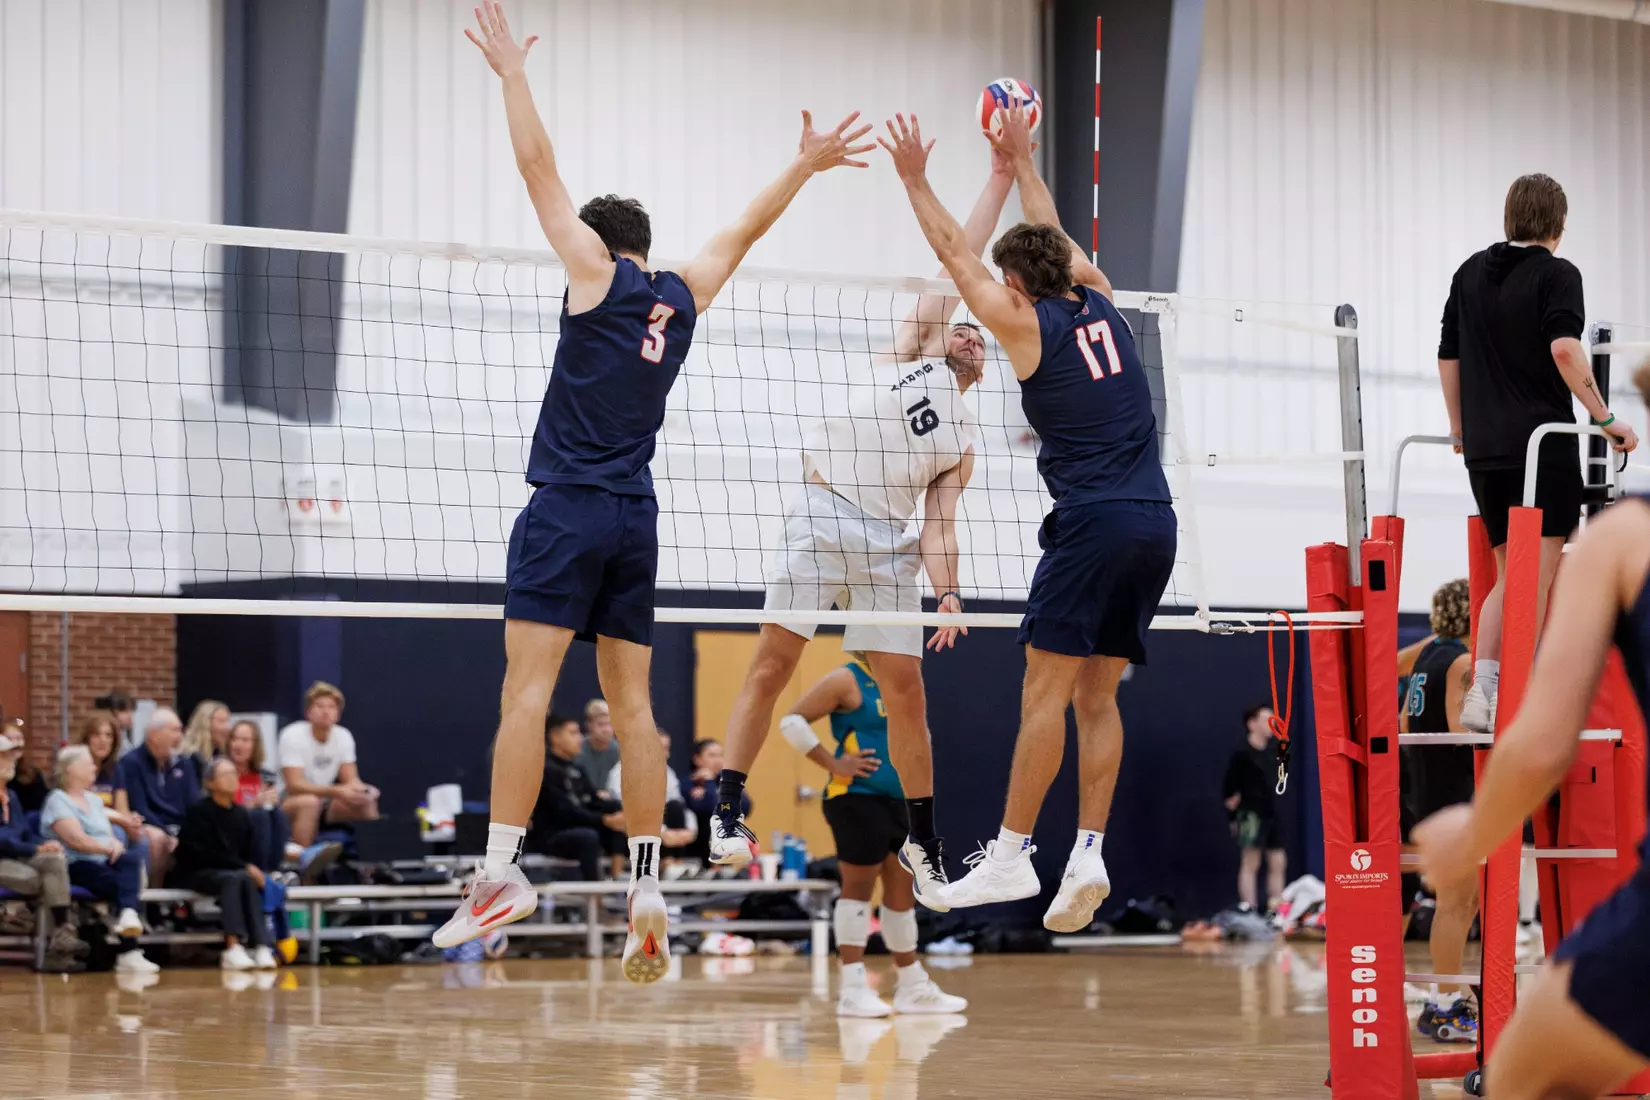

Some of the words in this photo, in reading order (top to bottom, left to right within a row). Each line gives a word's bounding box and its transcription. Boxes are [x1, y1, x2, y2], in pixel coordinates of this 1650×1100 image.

[640, 302, 676, 365] 3
[1074, 319, 1123, 382] 17
[891, 362, 944, 392] BERTY
[906, 395, 940, 437] 19
[1359, 872, 1389, 881] IMPORTS
[1350, 945, 1379, 1048] senoh
